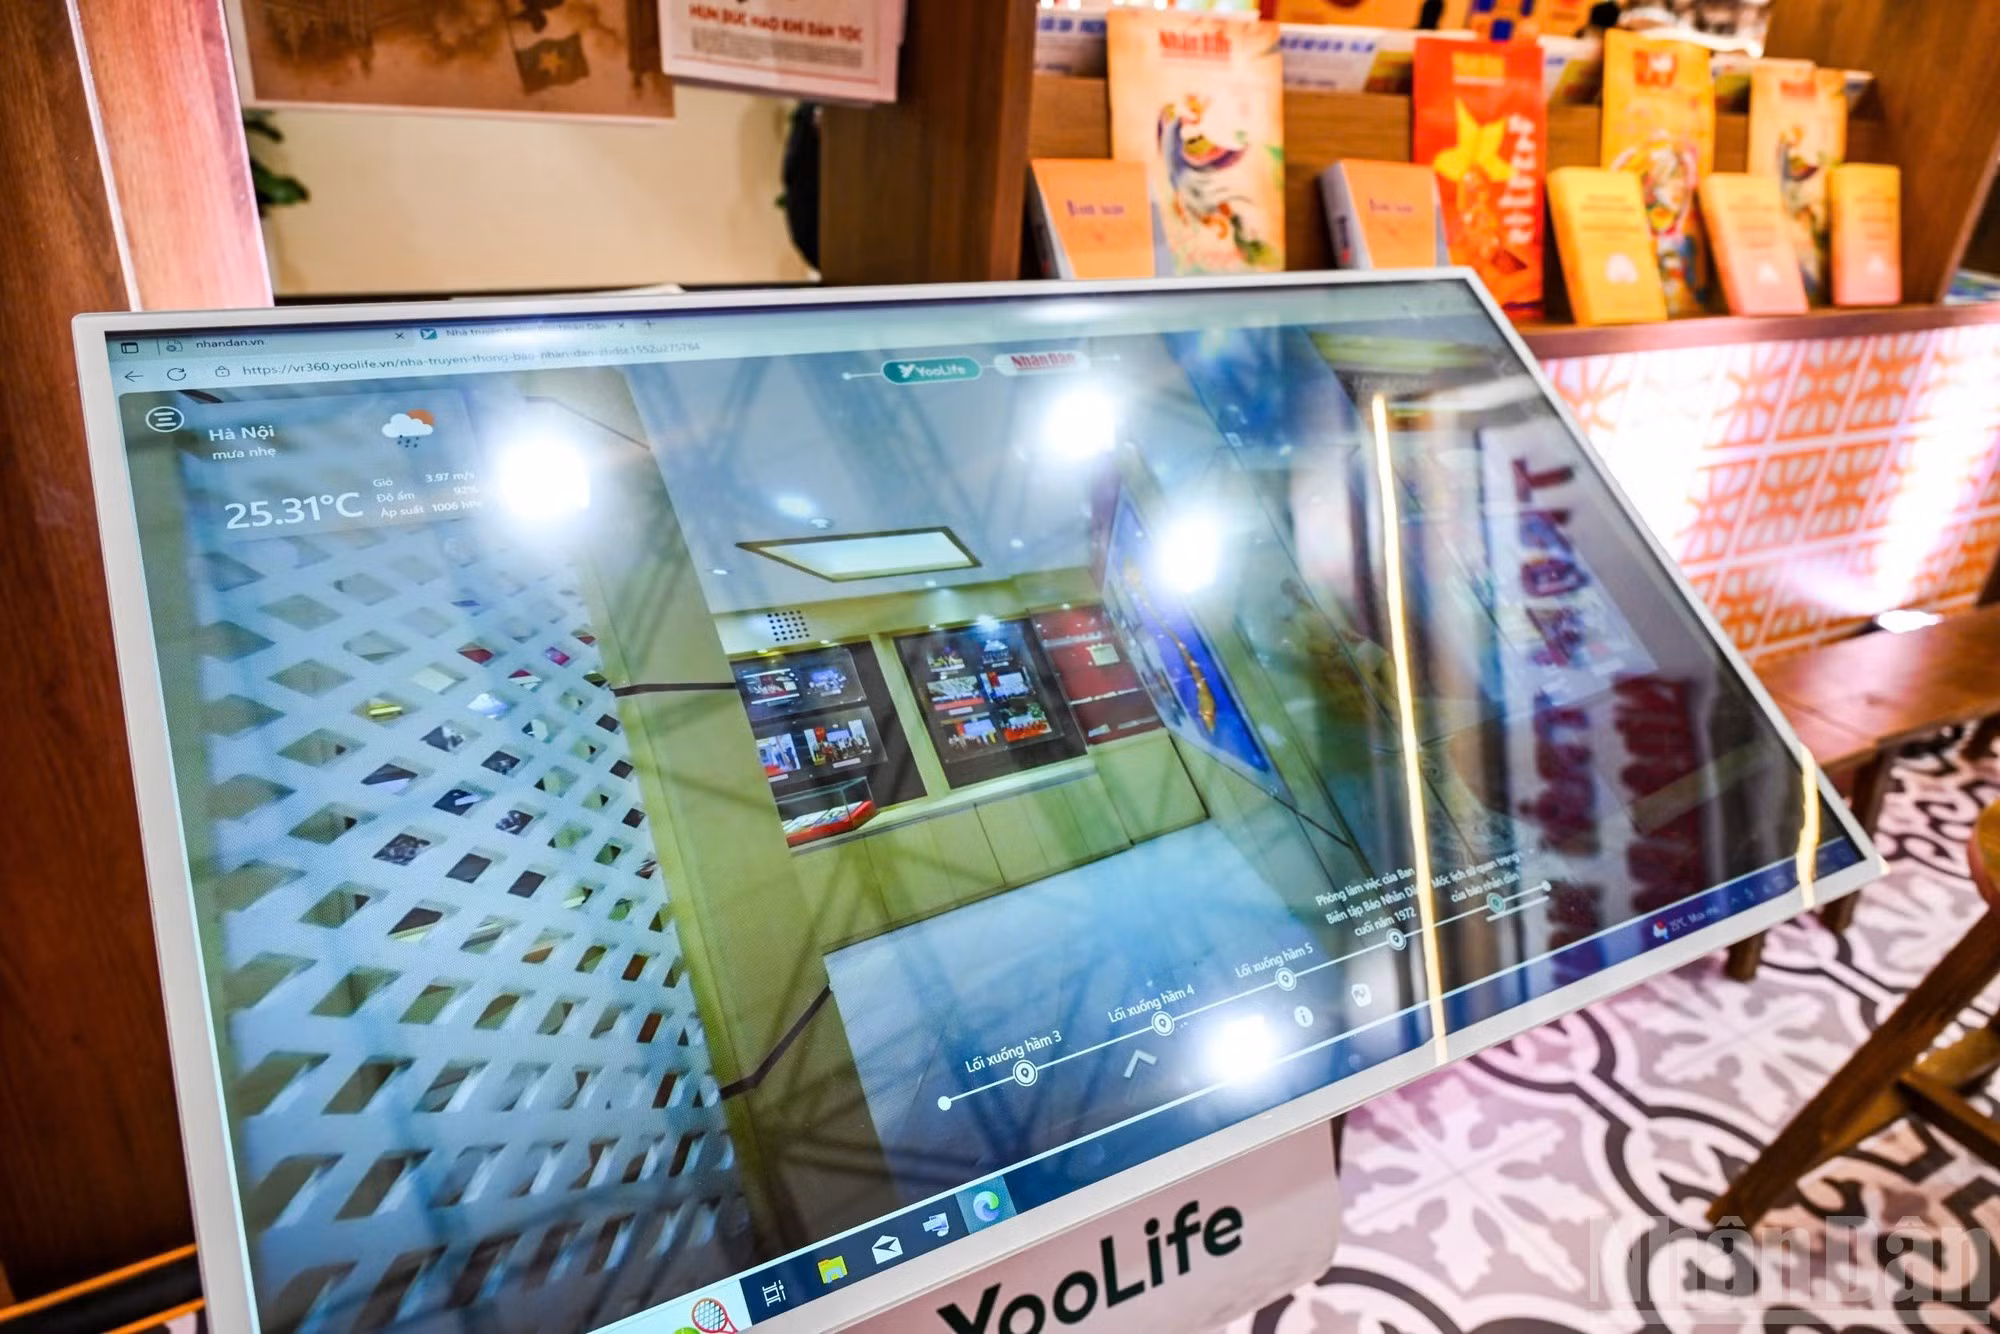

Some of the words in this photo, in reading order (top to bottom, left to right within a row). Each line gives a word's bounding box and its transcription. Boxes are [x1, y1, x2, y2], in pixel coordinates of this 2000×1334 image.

[196, 338, 264, 349] nhandan.vn
[917, 362, 966, 378] YooLife
[209, 428, 235, 441] Hà
[241, 424, 274, 440] Nội
[212, 449, 245, 460] mưa
[249, 446, 276, 457] nhẹ
[425, 472, 449, 483] 3.97
[453, 471, 475, 480] m/s
[224, 492, 363, 529] 25.31°C
[432, 501, 459, 512] 1006
[1476, 860, 1498, 874] quan
[1315, 889, 1347, 906] Phòng
[1346, 883, 1364, 897] làm
[1363, 877, 1382, 890] việc
[1397, 867, 1415, 880] Ban
[1483, 877, 1504, 890] nhân
[1326, 909, 1348, 924] Biên
[1347, 904, 1363, 918] tập
[1363, 898, 1381, 912] Báo
[1380, 890, 1405, 905] Nhân
[1374, 916, 1395, 930] năm
[1394, 907, 1417, 922] 1972
[1235, 962, 1253, 979] Lối
[1254, 953, 1283, 972] xuống
[1281, 946, 1306, 963] hầm
[1307, 943, 1315, 954] 5
[1108, 1006, 1125, 1023] Lối
[1127, 996, 1161, 1015] xuống
[1159, 986, 1187, 1005] hầm
[1187, 983, 1195, 996] 4
[965, 1056, 983, 1073] Lối
[986, 1045, 1024, 1067] xuống
[1024, 1034, 1053, 1054] hầm
[1053, 1030, 1062, 1043] 3
[936, 1199, 1243, 1334] YooLife
